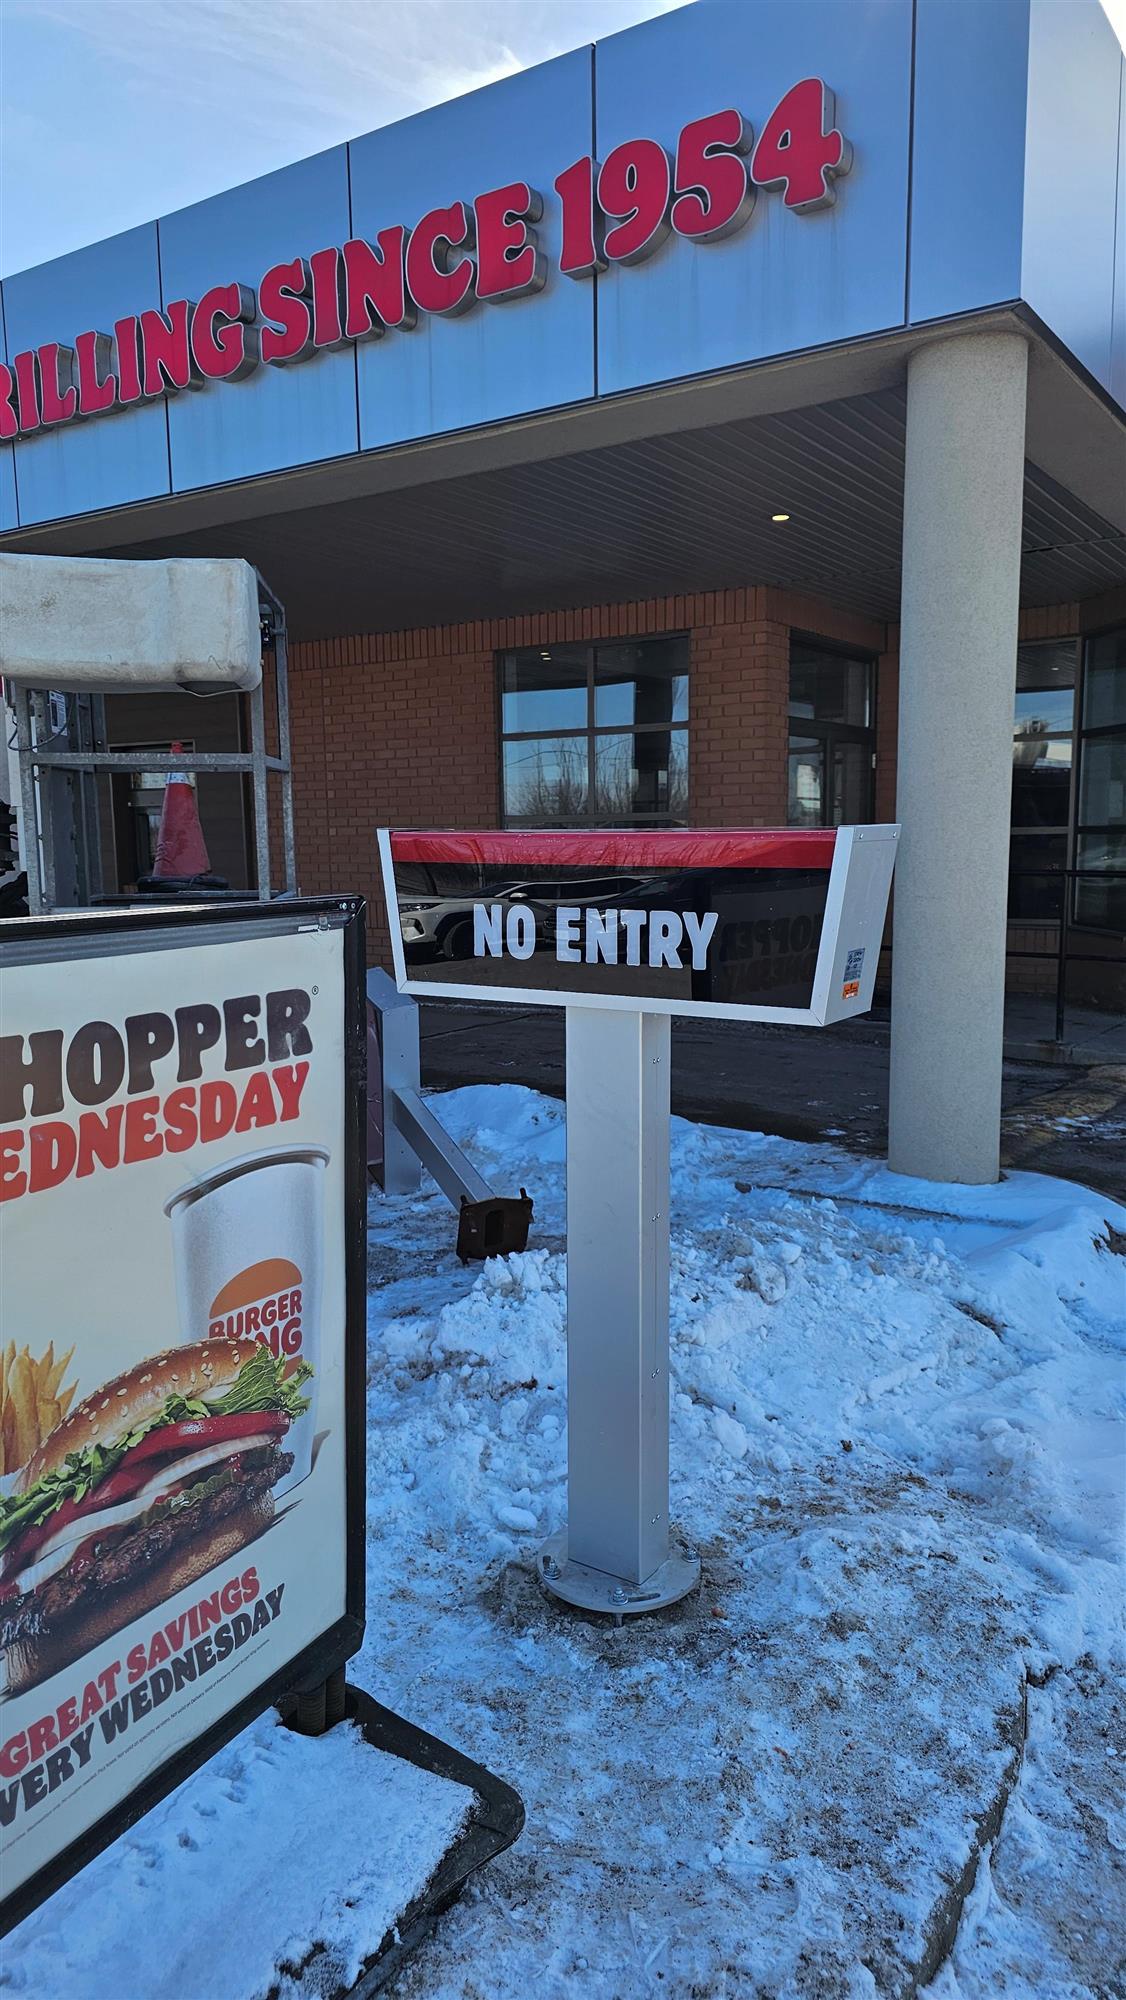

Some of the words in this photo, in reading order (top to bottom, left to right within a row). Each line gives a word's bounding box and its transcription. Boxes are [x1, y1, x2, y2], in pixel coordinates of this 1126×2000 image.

[259, 181, 537, 364] SINCE
[554, 76, 845, 274] 1954
[473, 903, 537, 960] NO
[556, 907, 719, 971] ENTRY
[0, 1061, 310, 1202] EDNESDAY
[209, 1289, 303, 1339] BURGER
[0, 1660, 121, 1778] GREAT
[127, 1566, 260, 1685] SAVINGS
[99, 1583, 285, 1745] WEDNESDAY
